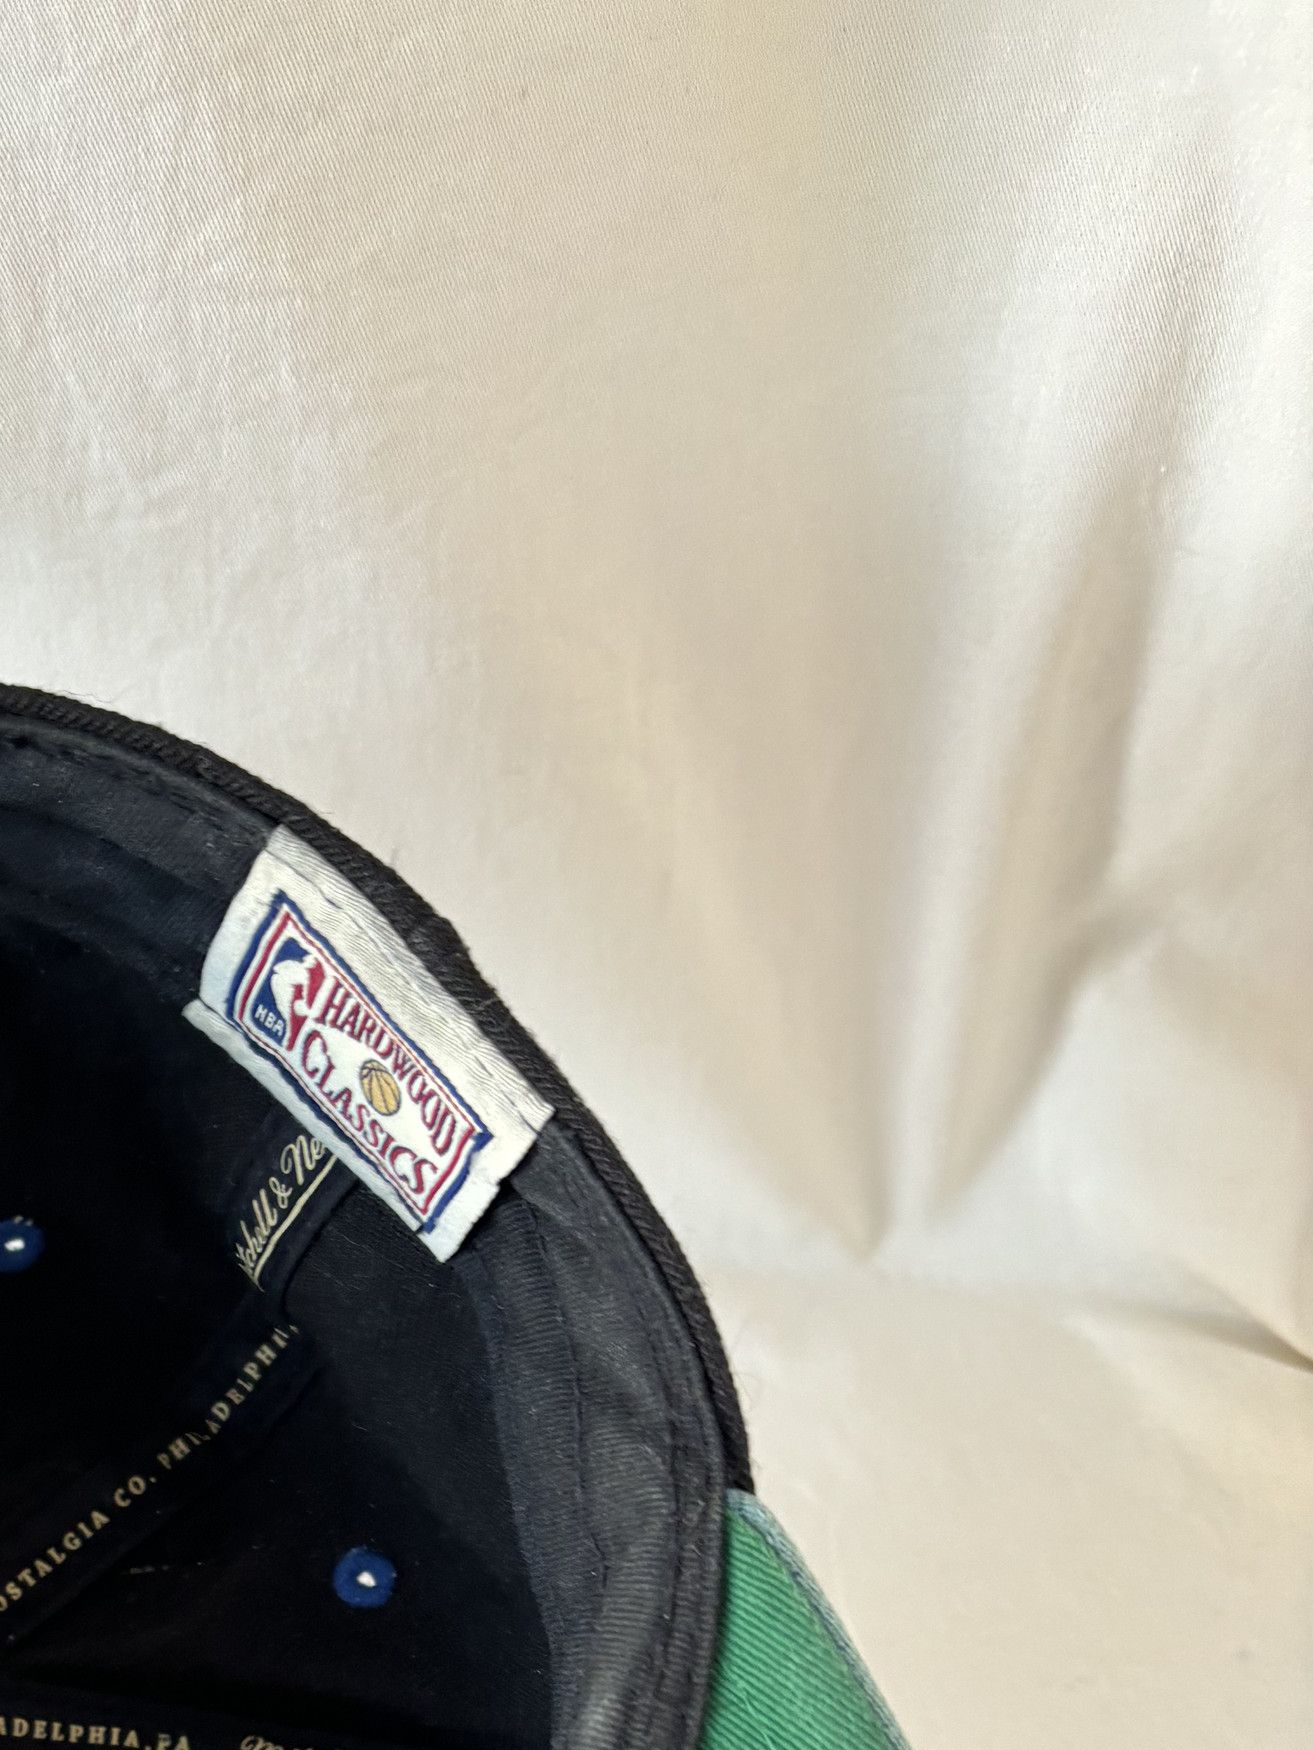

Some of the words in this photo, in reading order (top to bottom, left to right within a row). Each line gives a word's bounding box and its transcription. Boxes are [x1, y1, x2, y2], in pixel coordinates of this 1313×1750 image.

[253, 1002, 287, 1039] NBA
[317, 978, 459, 1157] HARDWOOD
[300, 1028, 439, 1195] CLASSICS
[280, 1131, 326, 1187] Ne
[112, 1474, 157, 1509] CO.
